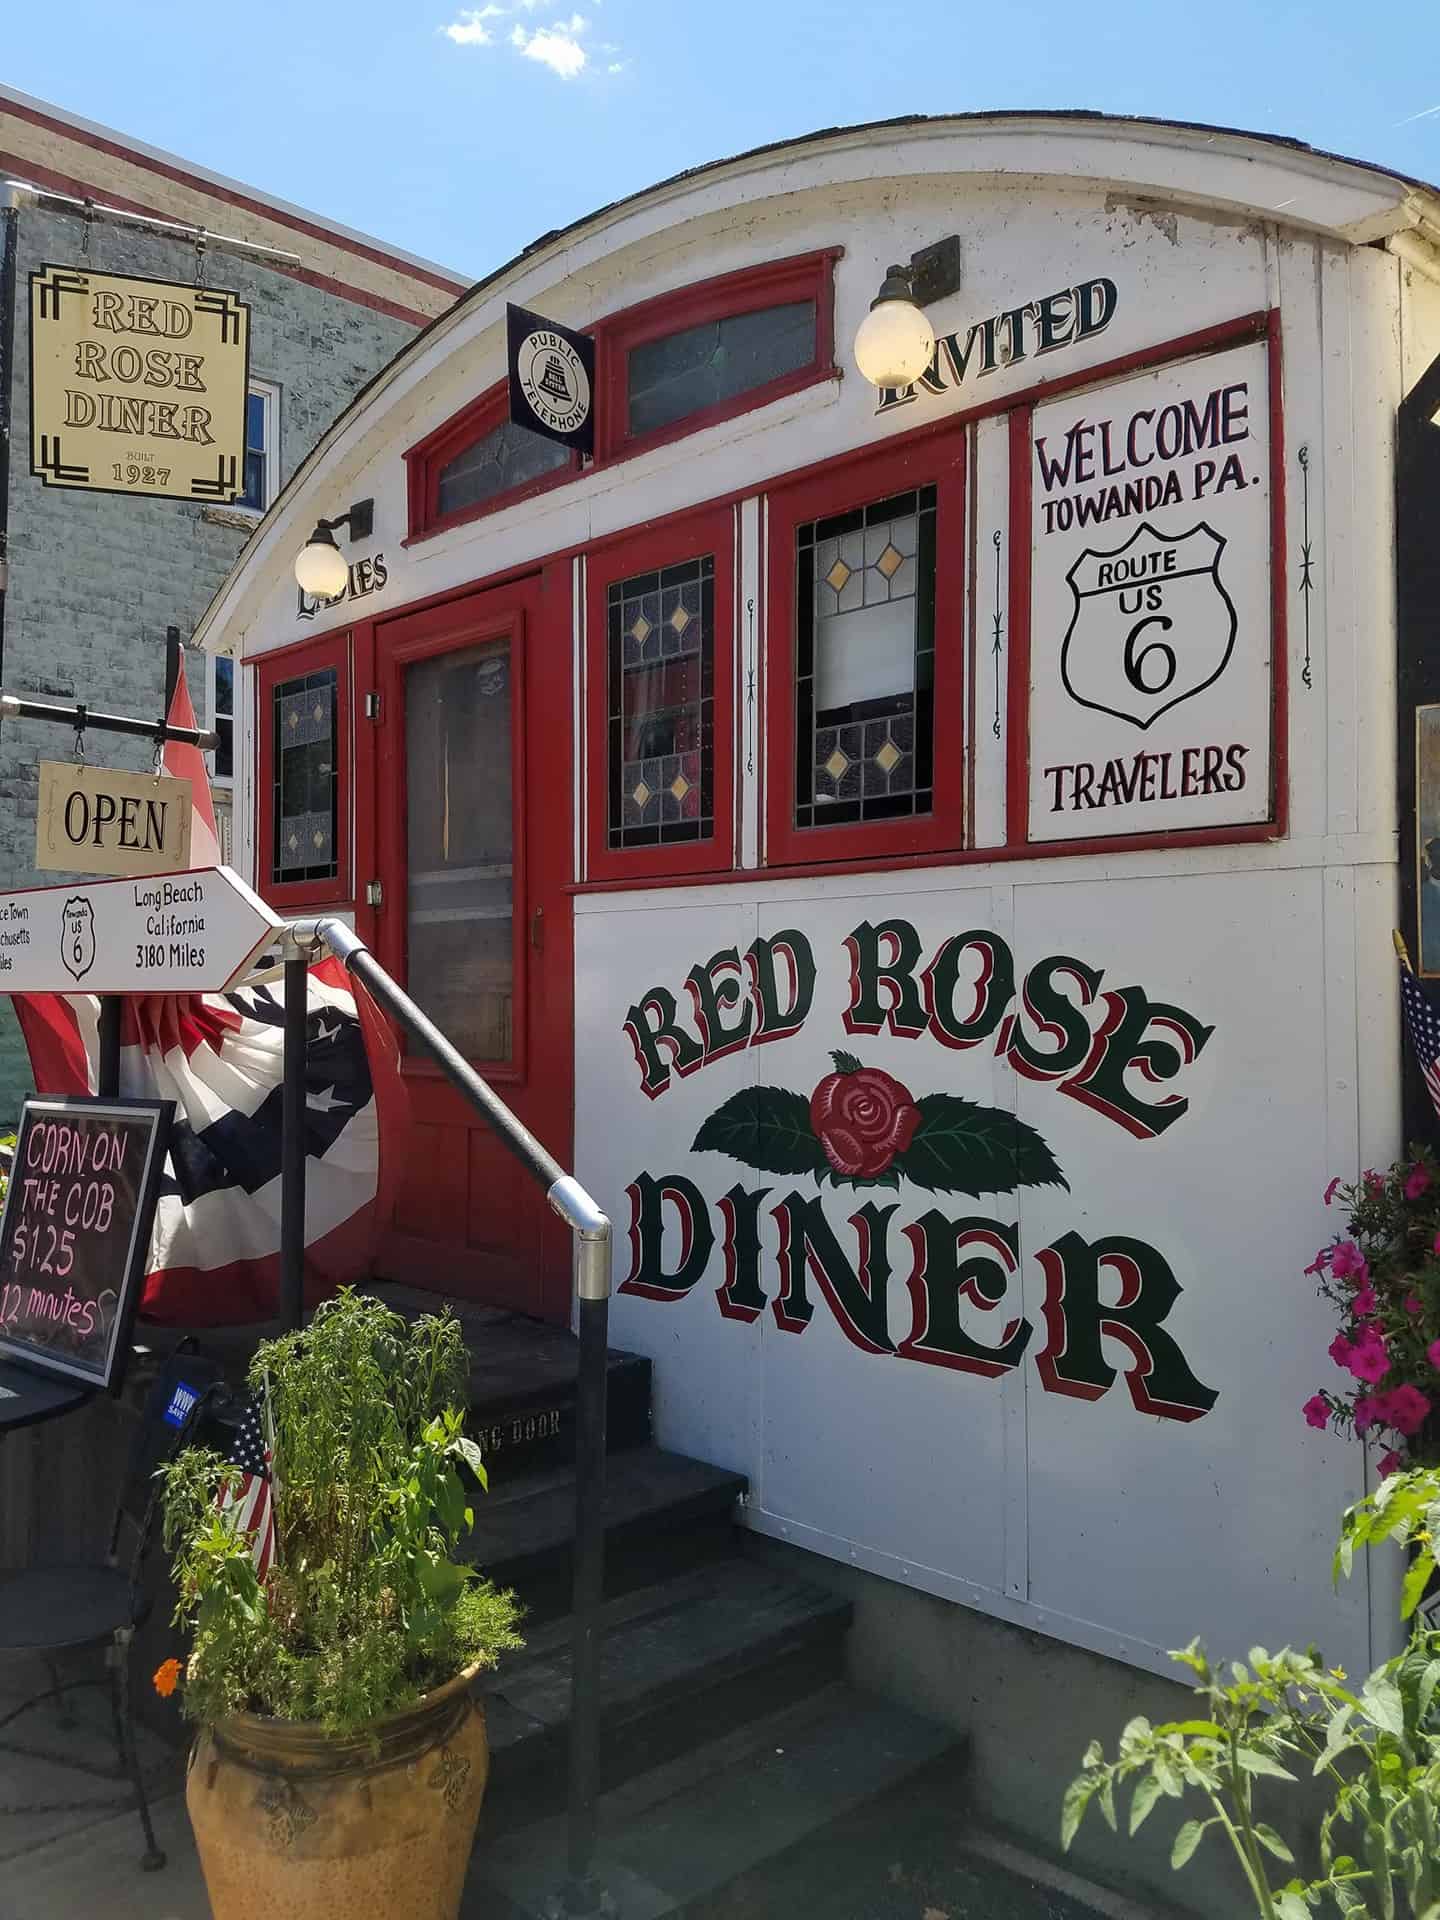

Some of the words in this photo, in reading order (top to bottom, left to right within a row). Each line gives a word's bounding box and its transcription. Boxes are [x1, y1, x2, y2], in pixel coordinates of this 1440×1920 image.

[92, 291, 194, 340] RED
[75, 340, 208, 392] ROSE
[529, 332, 580, 368] PUBLIC
[63, 389, 217, 446] DINER
[523, 377, 587, 431] TELEPHONE
[126, 451, 155, 463] BUILT
[1034, 382, 1250, 493] WELCOME
[111, 463, 172, 486] 1927
[1041, 469, 1183, 535] TOWANDA
[1192, 453, 1261, 500] PA.
[1097, 549, 1178, 588] ROUTE
[1118, 584, 1163, 615] US
[1124, 615, 1178, 695] 6
[1044, 743, 1251, 812] TRAVELERS
[64, 791, 168, 853] OPEN
[9, 902, 29, 921] Town
[134, 886, 161, 911] Long
[163, 882, 204, 904] Beach
[71, 919, 82, 934] US
[73, 936, 82, 964] 6
[146, 916, 206, 937] California
[135, 944, 165, 968] 3180
[169, 943, 205, 968] Miles
[622, 928, 817, 1100] RED
[841, 919, 1216, 1140] ROSE
[26, 1122, 90, 1176] CORN
[92, 1131, 128, 1171] ON
[22, 1179, 61, 1216] THE
[64, 1181, 115, 1233] COB
[12, 1216, 76, 1276] $1.25
[0, 1283, 21, 1325] 12
[25, 1286, 97, 1335] minutes
[617, 1170, 1220, 1423] DINER
